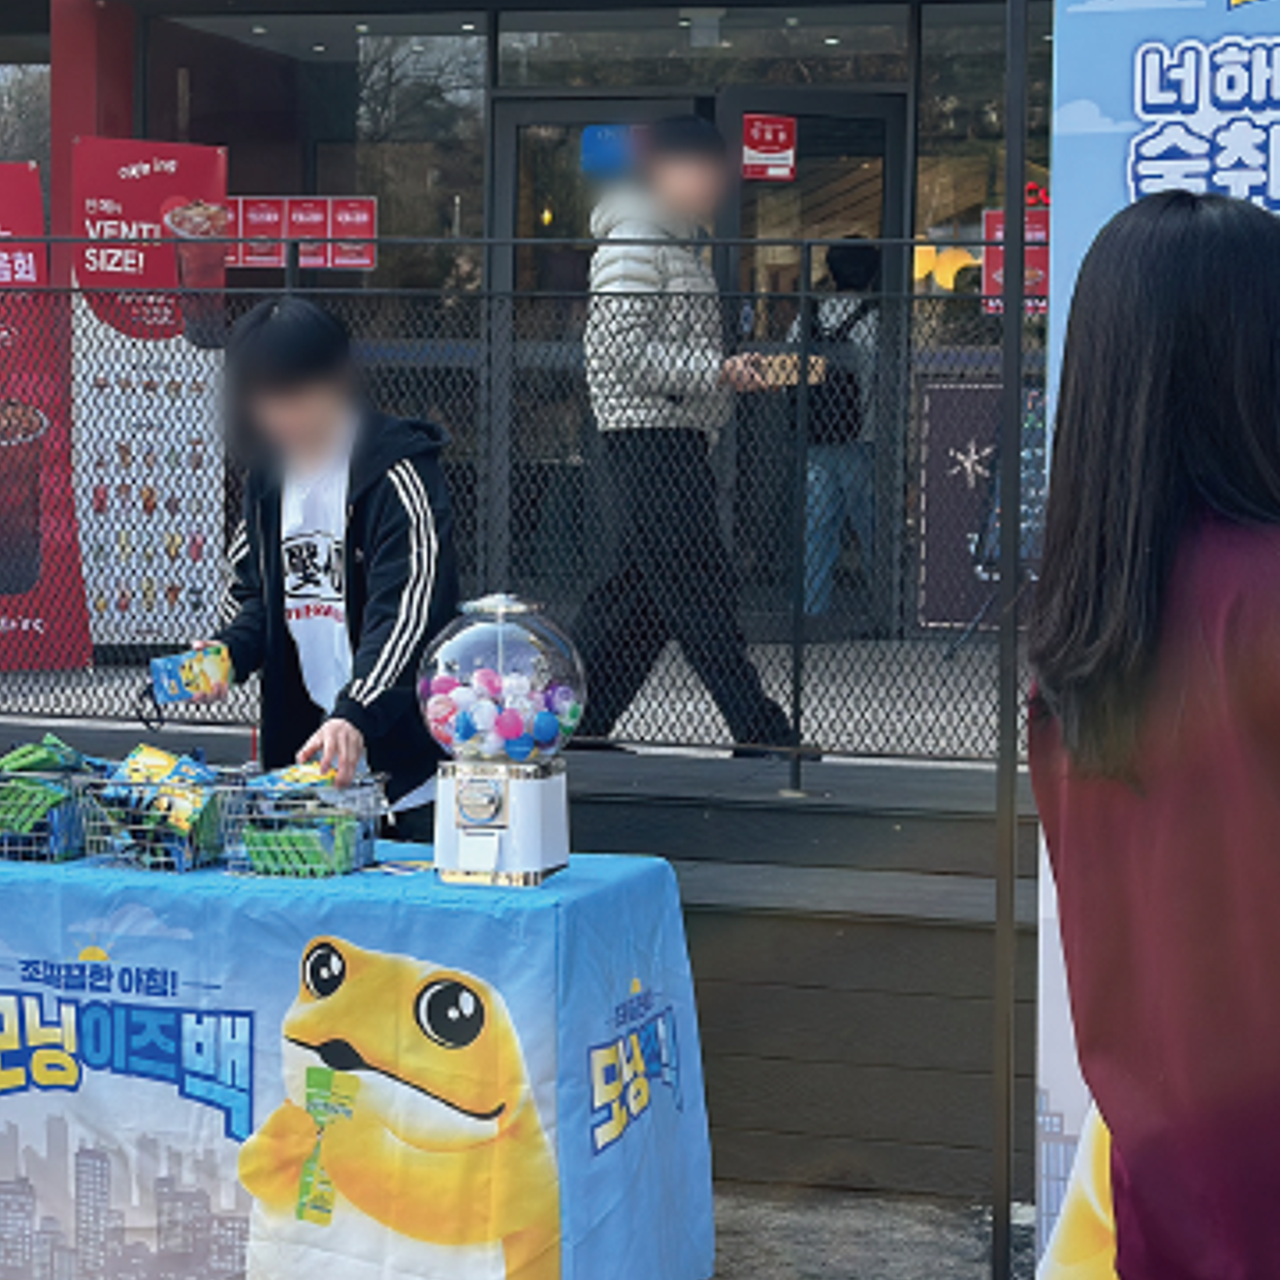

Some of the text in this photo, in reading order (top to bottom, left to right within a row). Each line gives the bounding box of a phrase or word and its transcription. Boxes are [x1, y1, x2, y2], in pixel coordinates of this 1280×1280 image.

[1140, 45, 1201, 110] 너
[85, 248, 144, 274] SIZE!
[117, 966, 179, 997] 아침!
